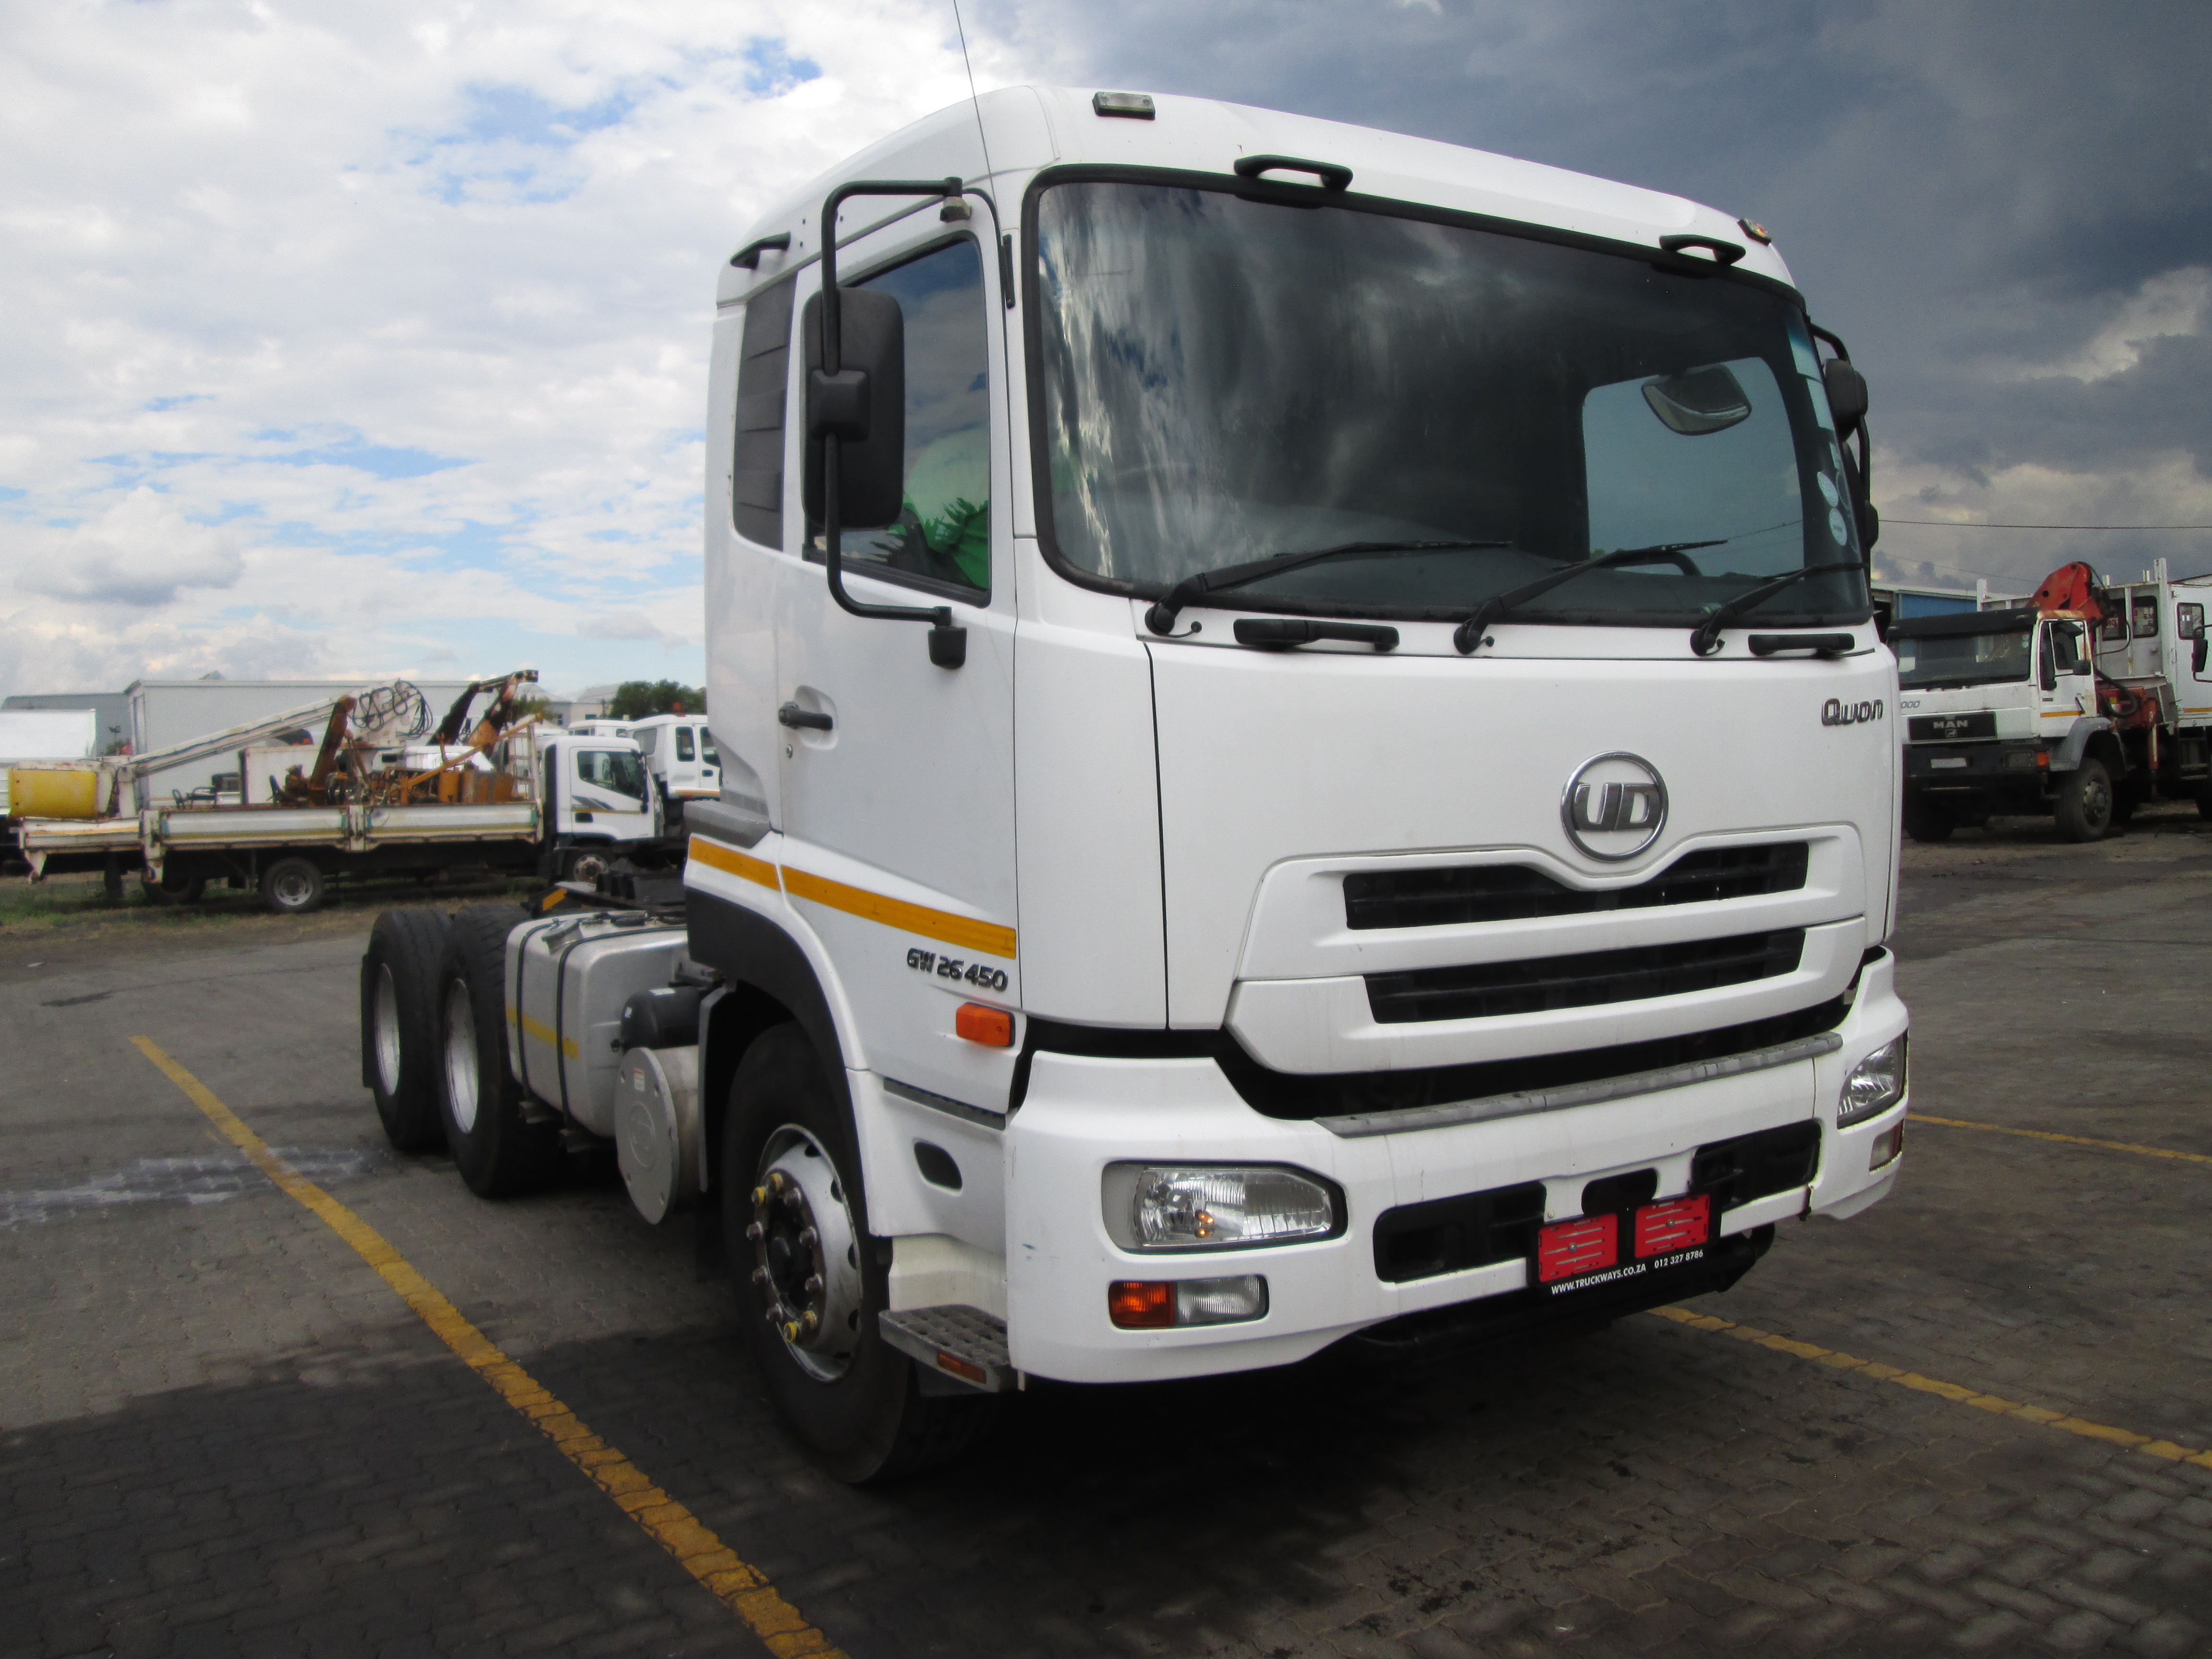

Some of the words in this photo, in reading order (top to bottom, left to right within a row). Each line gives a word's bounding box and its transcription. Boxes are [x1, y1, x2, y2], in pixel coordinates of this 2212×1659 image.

[1933, 720, 1968, 729] MAN
[1573, 782, 1660, 831] UD
[907, 948, 936, 973] GW
[937, 955, 964, 980] 26
[964, 963, 1008, 991] 450
[1551, 1263, 1647, 1295] WWW.TRUCKWAYS.CO.ZA
[1654, 1259, 1668, 1269] 012
[1670, 1254, 1683, 1265] 327
[1685, 1249, 1704, 1261] 8786
